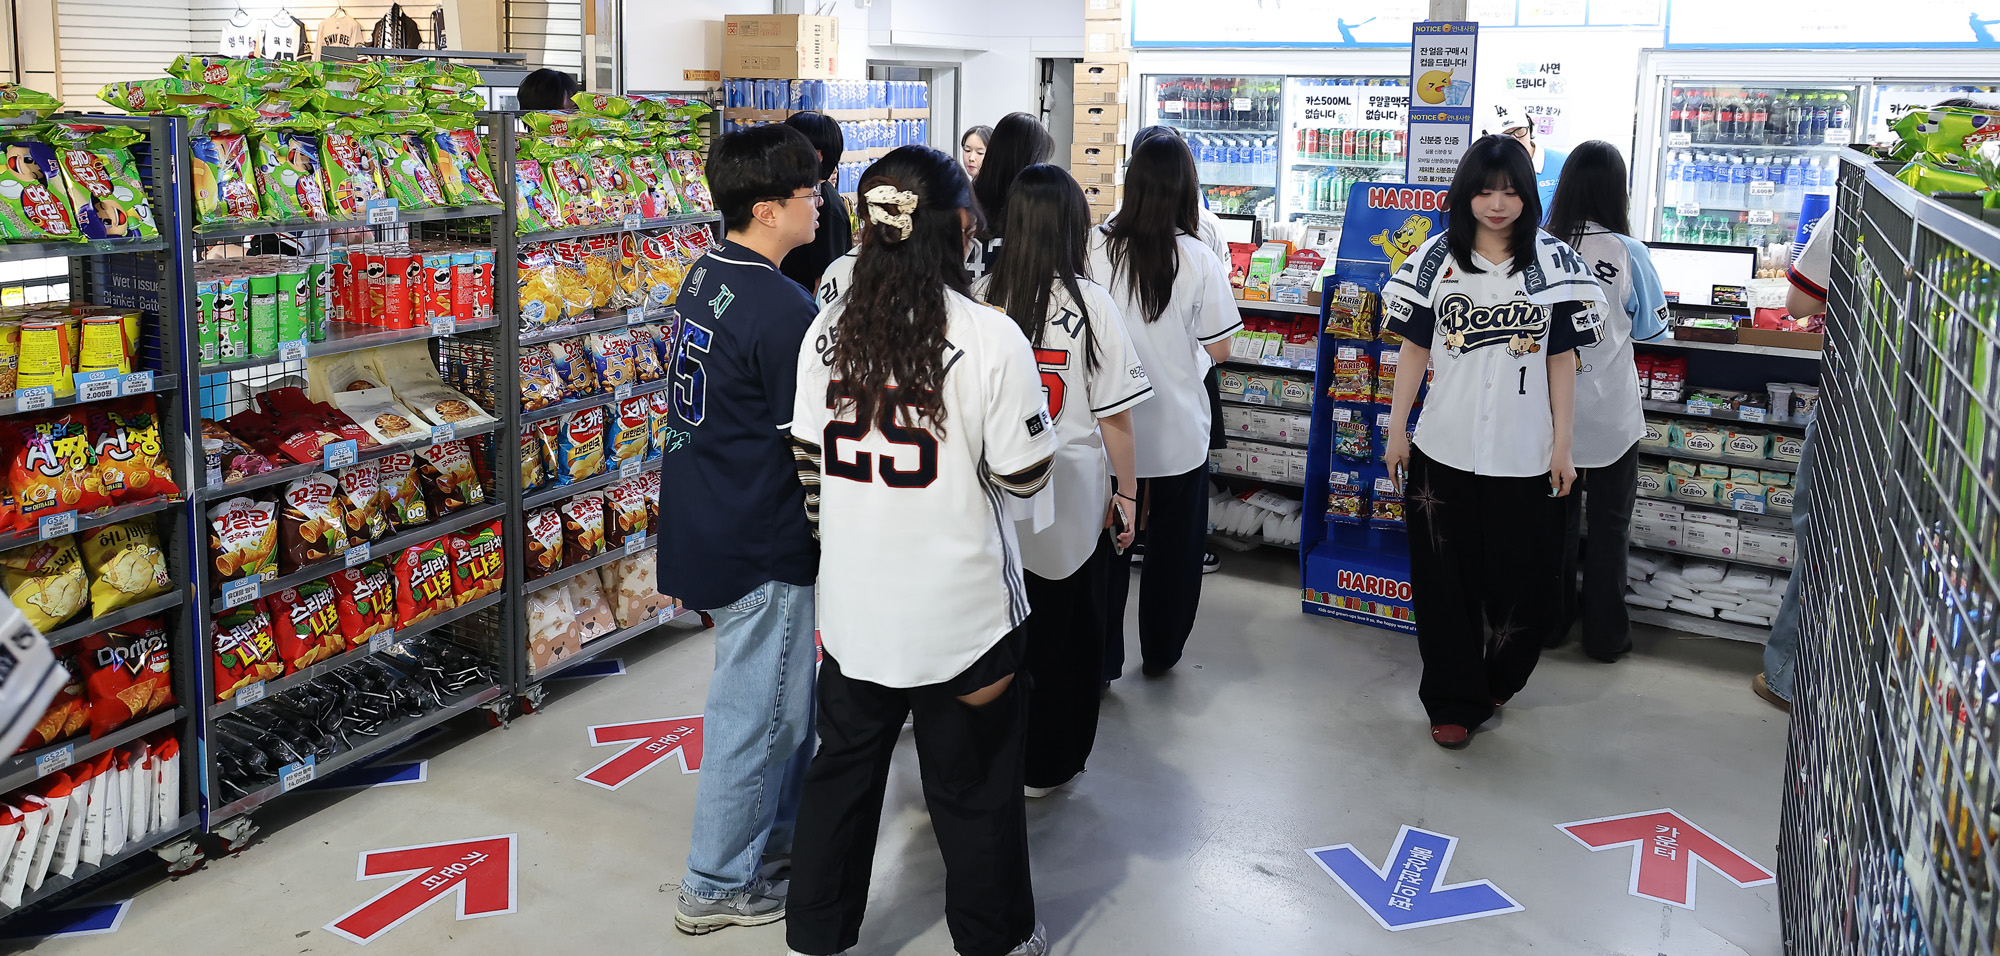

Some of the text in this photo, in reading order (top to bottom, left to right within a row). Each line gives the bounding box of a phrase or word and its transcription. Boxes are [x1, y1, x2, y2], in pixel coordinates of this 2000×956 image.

[1420, 47, 1468, 56] 잔 얼음 구매 시
[1420, 58, 1467, 67] 컵을 드립니다!
[1540, 63, 1561, 74] 사면
[1305, 108, 1336, 119] 없습니다
[1366, 109, 1398, 120] 없습니다
[1419, 136, 1460, 146] 신분증 인증
[65, 150, 112, 197] 홈런볼
[1369, 187, 1450, 212] HARIBO
[24, 184, 71, 235] 홈런볼
[112, 273, 131, 289] Wet
[1418, 260, 1436, 288] CLUB
[103, 291, 136, 308] Blanket
[1442, 294, 1547, 331] Bears
[90, 371, 105, 379] GS25
[673, 315, 714, 427] 5
[1518, 366, 1526, 395] 1
[23, 389, 46, 397] GS25
[86, 390, 112, 399] 2,000원
[622, 426, 647, 440] 대한민국
[824, 379, 938, 489] 25
[1338, 421, 1365, 431] HARIBO
[96, 425, 162, 462] 신짱
[575, 437, 600, 455] 대한민국
[1690, 440, 1710, 449] 보솜이
[1732, 440, 1753, 450] 보솜이
[25, 434, 89, 477] 신짱
[471, 488, 484, 499] OC
[1682, 486, 1702, 496] 보솜이
[47, 515, 70, 525] GS25
[407, 507, 425, 519] OC
[215, 509, 269, 536] 꼬깔콘
[336, 539, 349, 549] OC
[456, 535, 502, 567] 스리라차
[1338, 570, 1412, 600] HARIBO
[289, 586, 335, 626] 스리라차
[1335, 611, 1357, 619] grown-ups
[1383, 620, 1396, 628] happy
[215, 612, 270, 655] 스리라차
[98, 632, 168, 666] Doritos
[646, 725, 695, 754] 카운터
[43, 749, 66, 763] GS25
[1653, 824, 1681, 861] 카운터
[420, 850, 489, 891] 카운터
